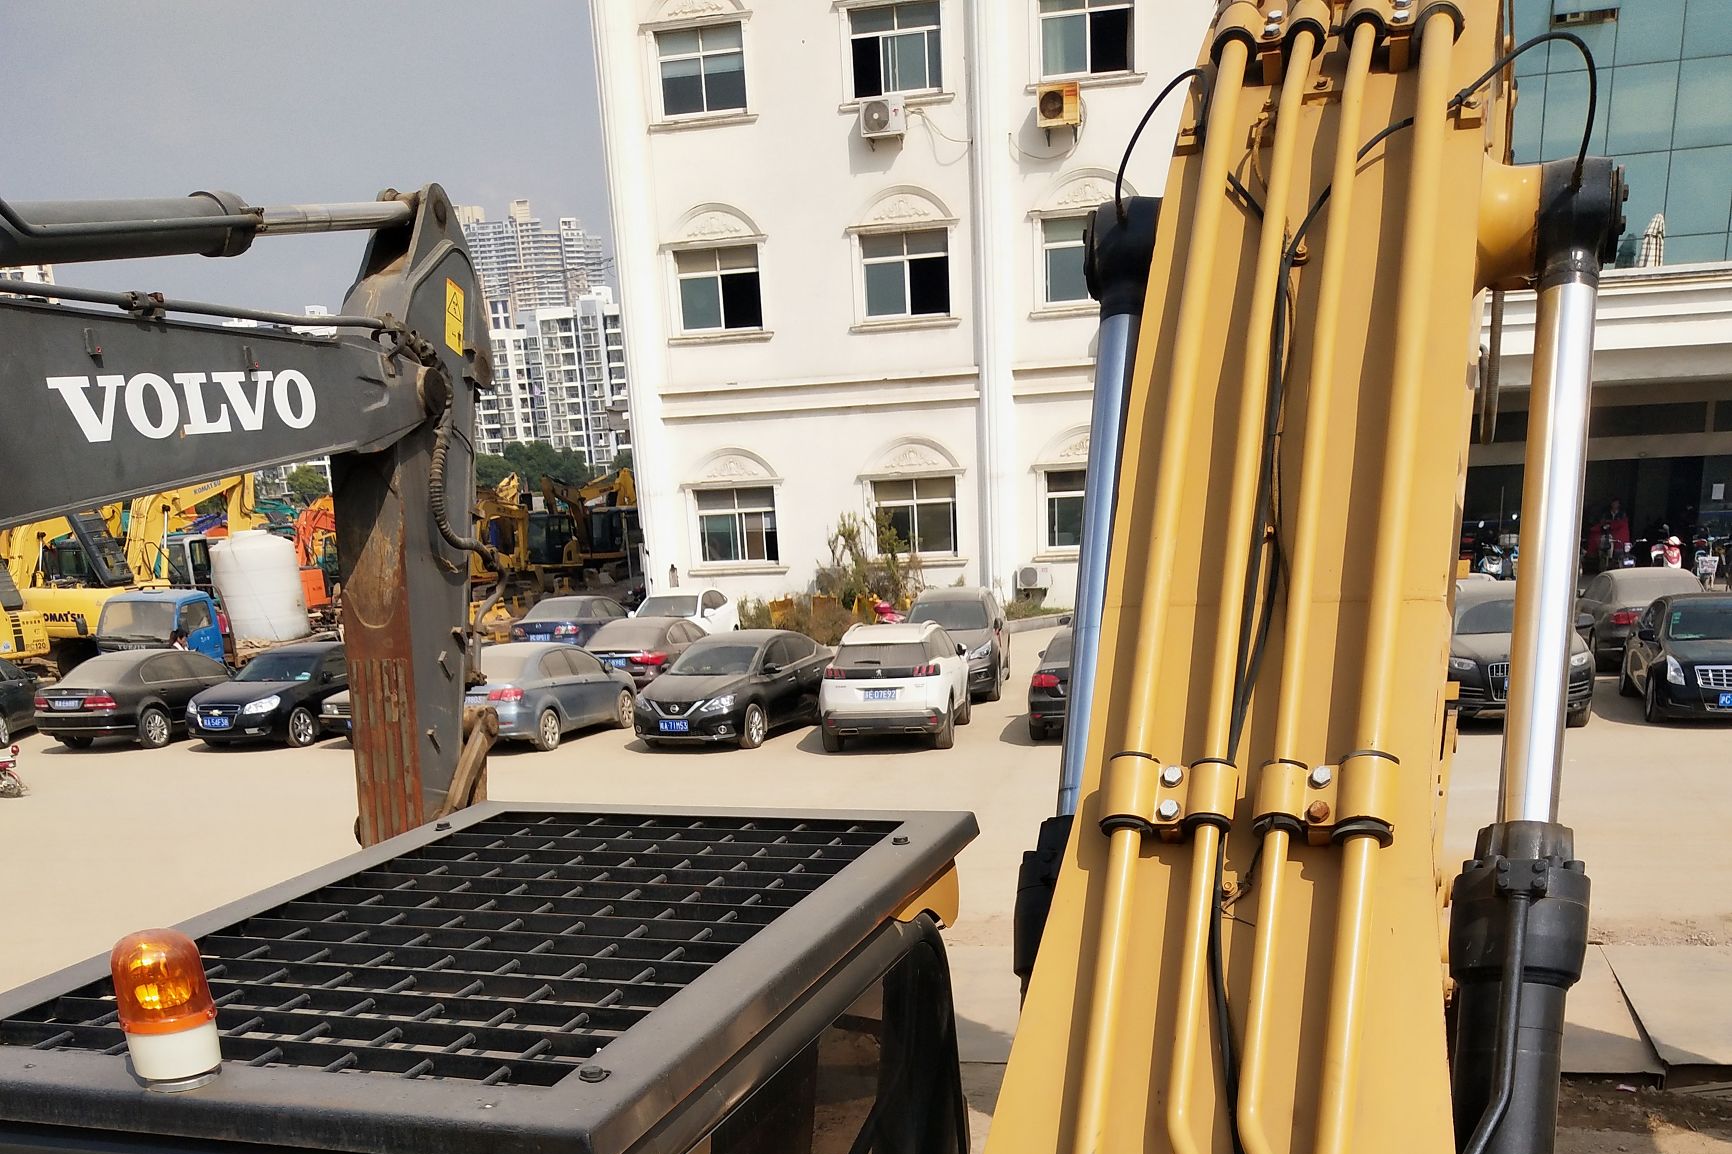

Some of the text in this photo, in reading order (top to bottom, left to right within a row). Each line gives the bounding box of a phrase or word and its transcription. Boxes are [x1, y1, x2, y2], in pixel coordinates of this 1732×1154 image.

[46, 369, 317, 443] VOLVO
[193, 480, 221, 496] KOMATSU
[43, 611, 84, 623] OMATSU
